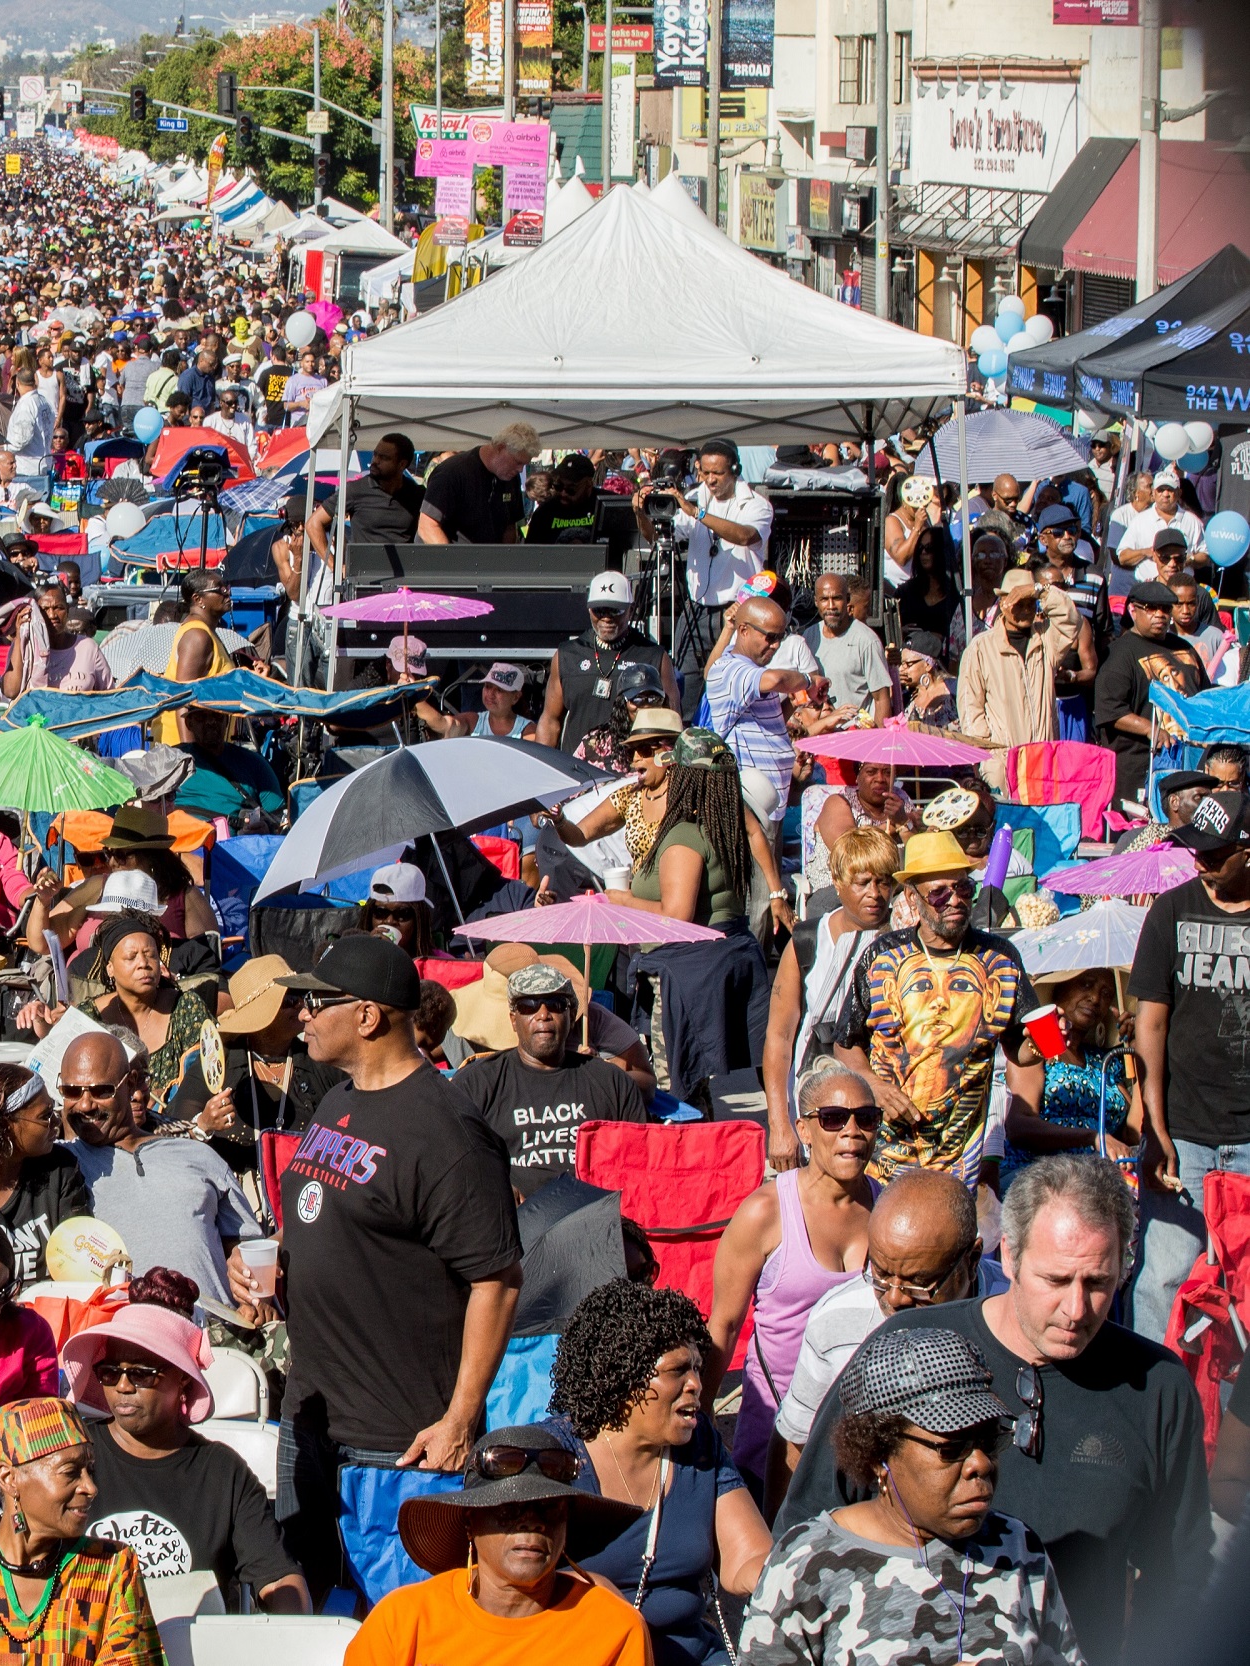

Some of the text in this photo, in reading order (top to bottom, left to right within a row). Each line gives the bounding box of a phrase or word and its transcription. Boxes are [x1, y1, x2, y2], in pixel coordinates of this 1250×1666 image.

[517, 8, 550, 17] INFINITY
[517, 16, 550, 25] MIRRORS
[631, 29, 650, 39] Shop
[682, 0, 705, 66] Kusa
[486, 2, 502, 81] Kusama
[624, 38, 643, 47] Mart
[466, 33, 488, 86] Yayoi
[734, 63, 770, 76] BROAD
[523, 80, 549, 89] BROAD
[160, 120, 174, 130] King
[420, 113, 461, 132] Krspy
[611, 82, 622, 170] gateway
[736, 124, 760, 132] REAR
[950, 107, 1044, 153] Love's Furniture
[1186, 385, 1218, 397] 94.7
[1186, 397, 1218, 410] THE
[1178, 922, 1250, 954] GUES
[1176, 954, 1250, 989] JEAN
[513, 1103, 587, 1126] BLACK
[523, 1126, 579, 1149] LIVES
[510, 1149, 576, 1167] MATTE
[90, 1257, 104, 1269] Tour
[90, 1514, 177, 1540] Ghetto
[145, 1537, 157, 1546] a
[173, 1548, 189, 1563] of
